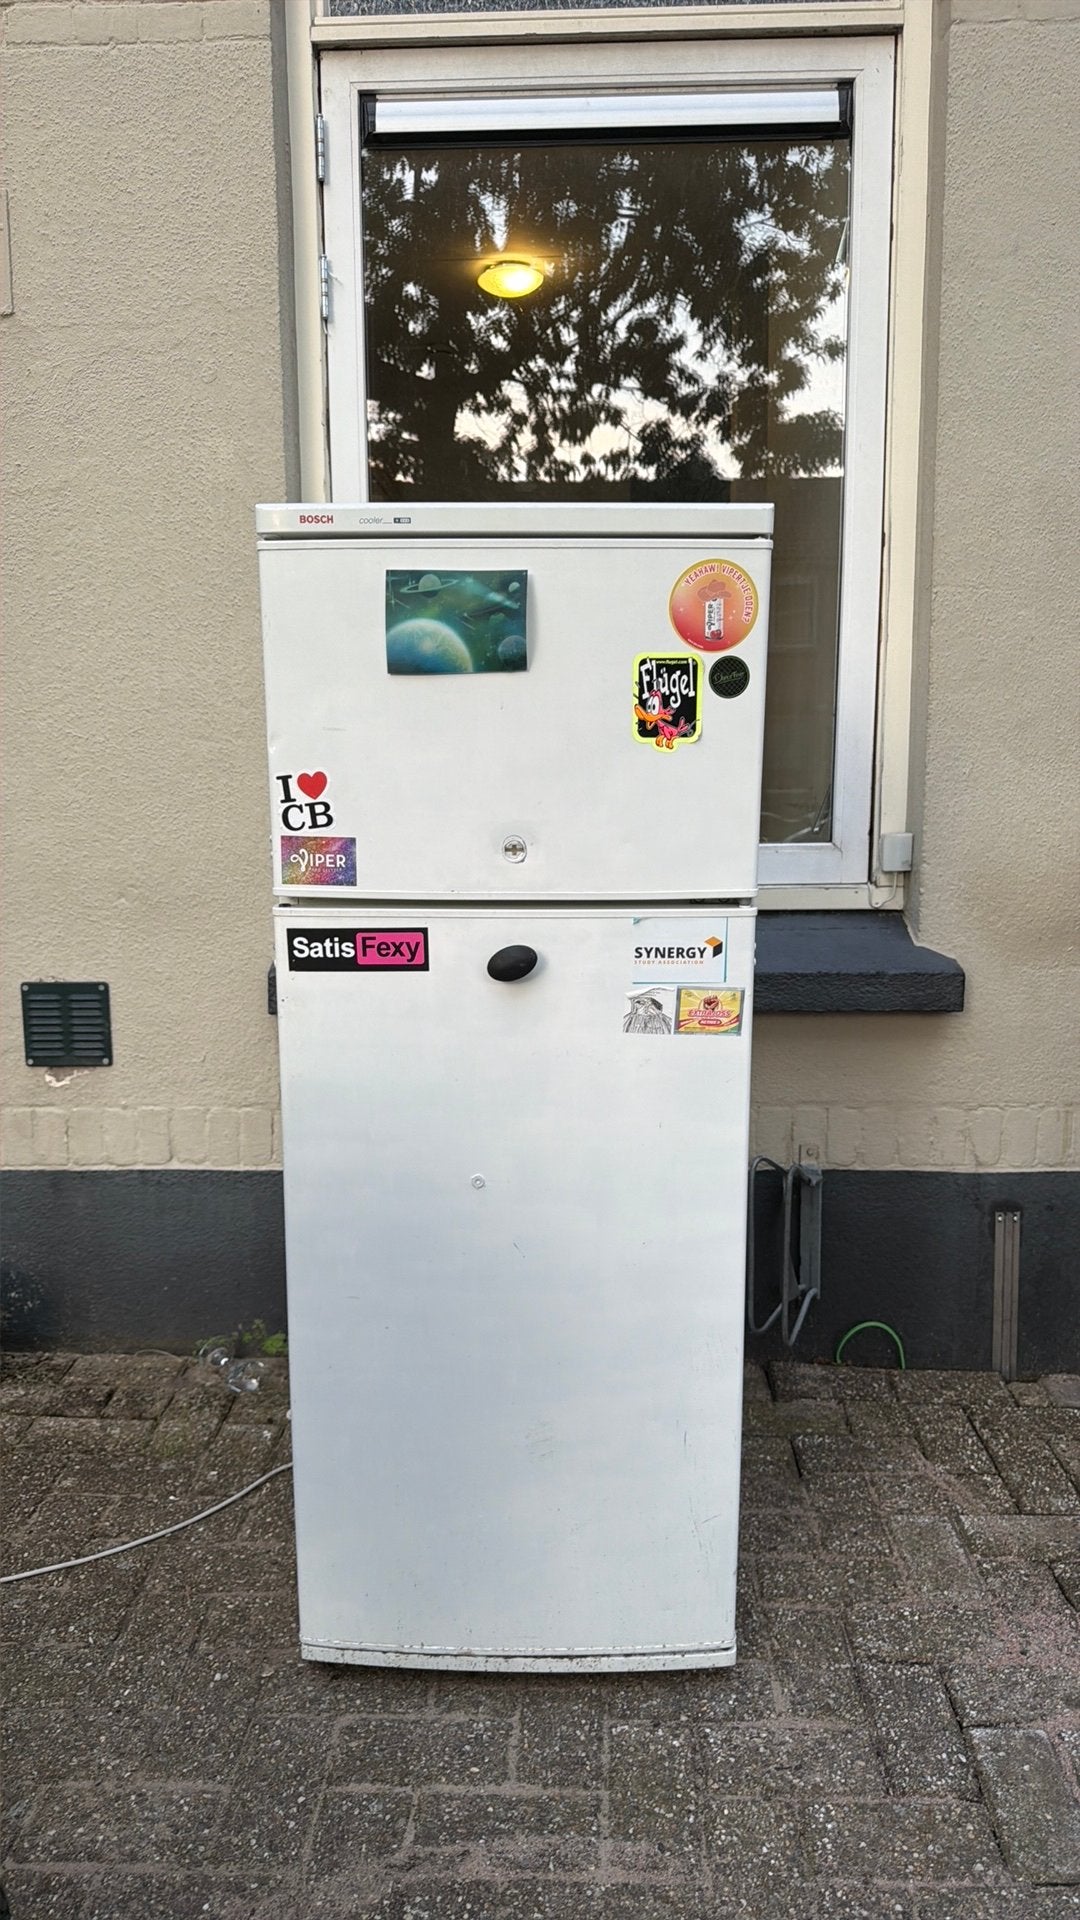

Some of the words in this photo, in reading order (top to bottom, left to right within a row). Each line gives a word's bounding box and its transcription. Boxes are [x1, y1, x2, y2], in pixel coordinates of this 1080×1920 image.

[299, 515, 334, 524] BOSCH
[640, 657, 696, 708] Flügel
[276, 774, 297, 804] I
[281, 801, 334, 831] CB
[290, 848, 346, 872] VIPER
[634, 946, 707, 959] SYNERGY
